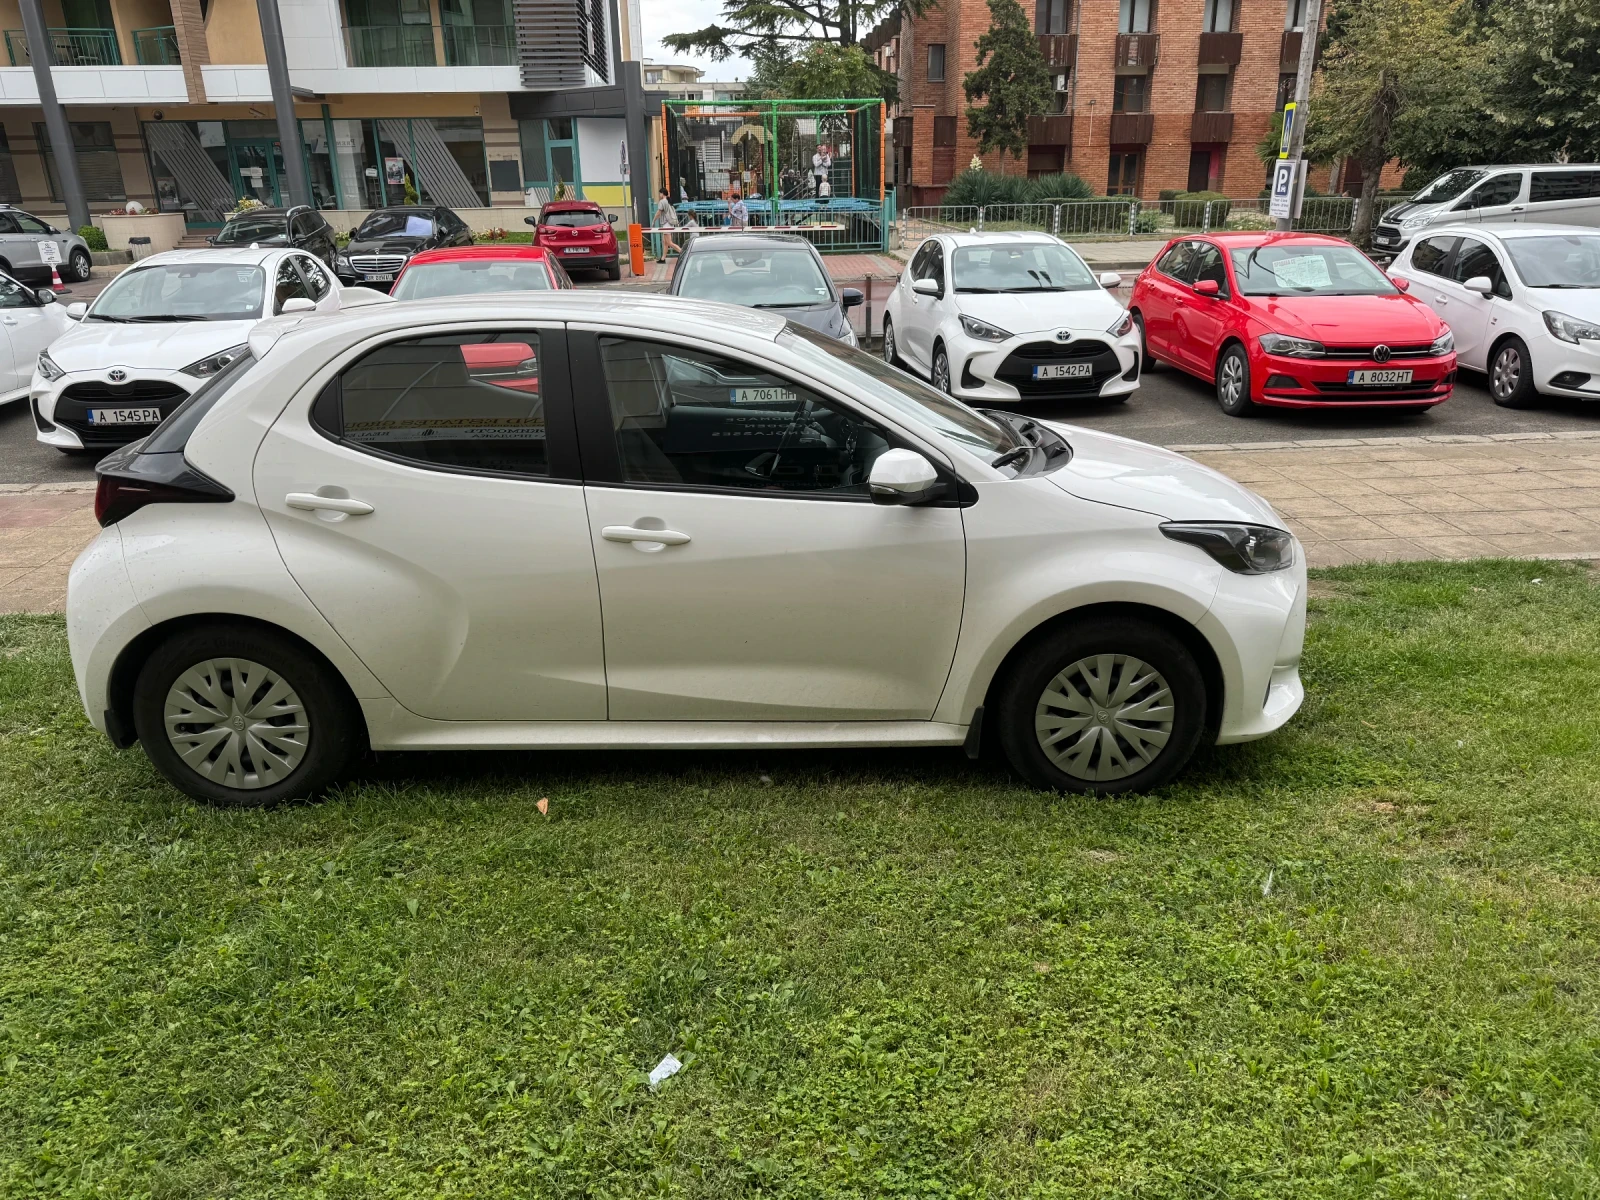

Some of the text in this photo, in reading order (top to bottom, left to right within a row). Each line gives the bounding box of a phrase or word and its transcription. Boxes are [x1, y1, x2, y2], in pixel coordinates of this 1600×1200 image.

[1277, 169, 1288, 192] P
[1042, 367, 1049, 377] A
[1358, 372, 1365, 382] A
[742, 390, 748, 401] A
[100, 411, 107, 422] A
